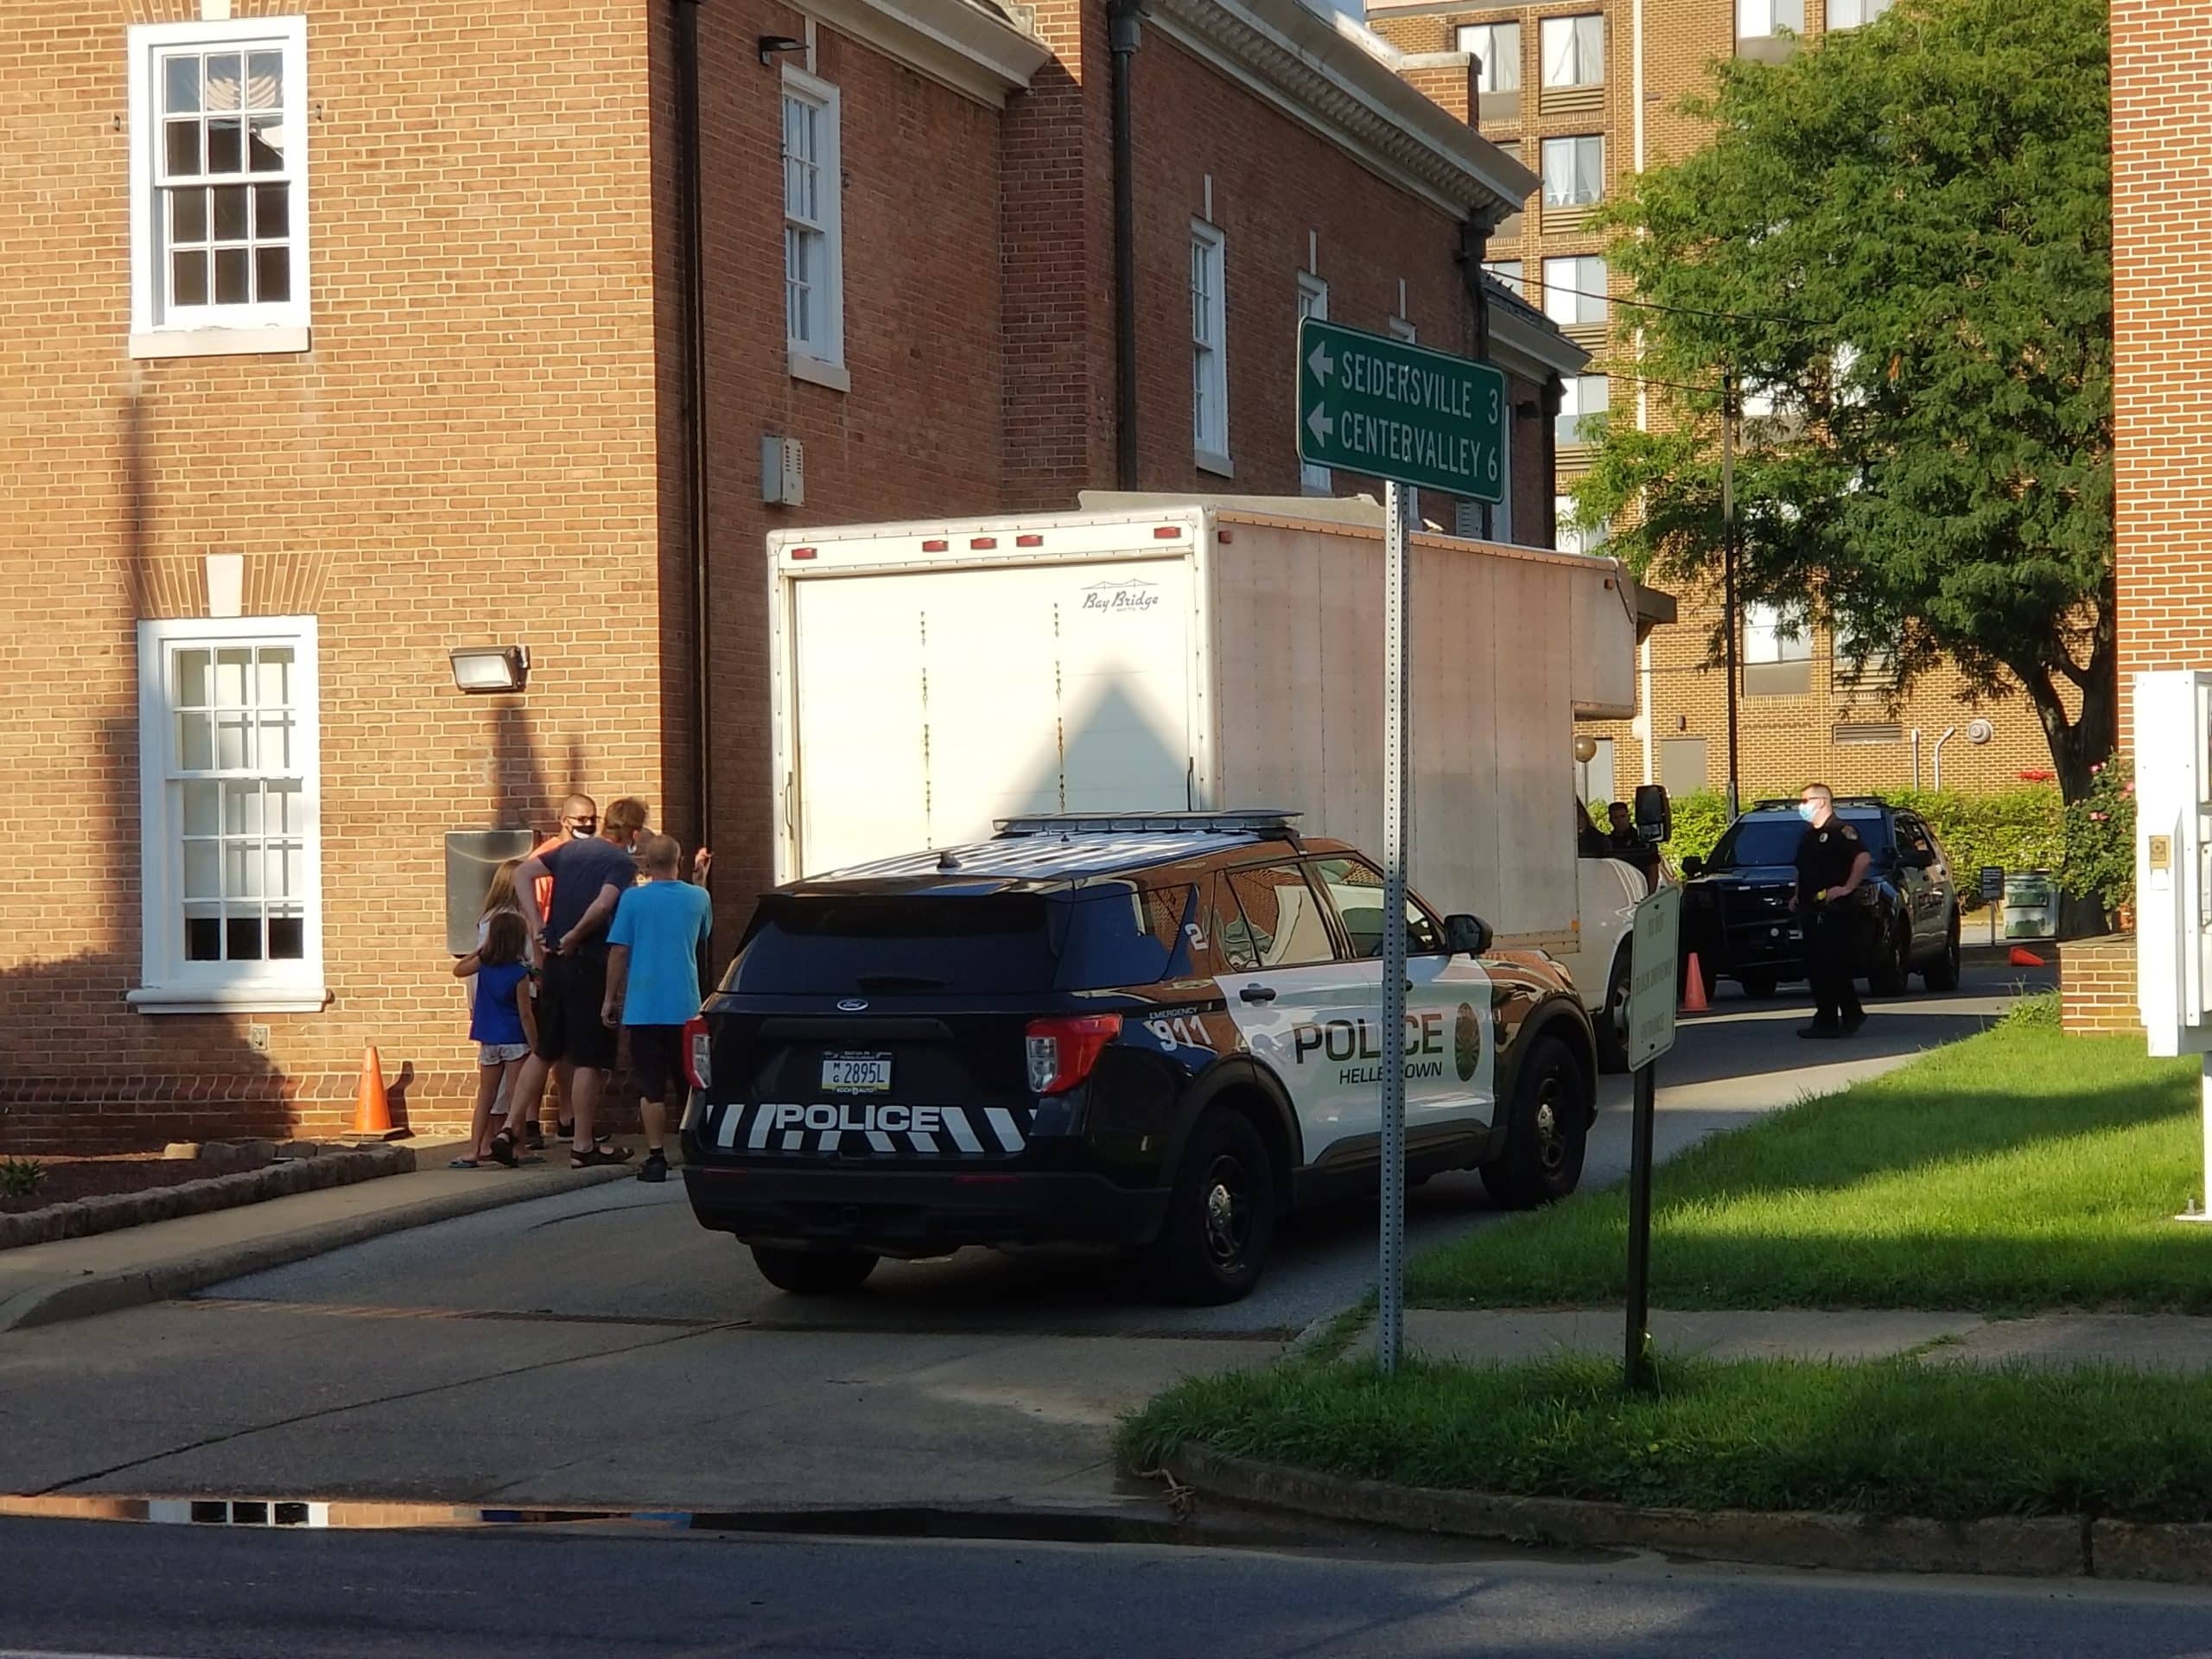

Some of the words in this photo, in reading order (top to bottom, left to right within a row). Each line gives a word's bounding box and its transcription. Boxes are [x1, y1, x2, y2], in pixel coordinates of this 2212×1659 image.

[1341, 351, 1472, 418] SEIDERSVILLE
[1488, 388, 1498, 424] 3
[1341, 410, 1481, 477] CENTERVALLEY
[1488, 447, 1497, 481] 6
[1082, 592, 1110, 613] Bay
[1111, 590, 1159, 611] Bridge
[1185, 923, 1209, 950] 2
[1149, 1006, 1198, 1020] EMERGENCY
[1153, 1015, 1212, 1052] 911
[1292, 1014, 1443, 1065] POLCE
[844, 1062, 885, 1084] 2895L
[1339, 1062, 1442, 1085] HELLEOWN
[776, 1104, 940, 1132] POLICE
